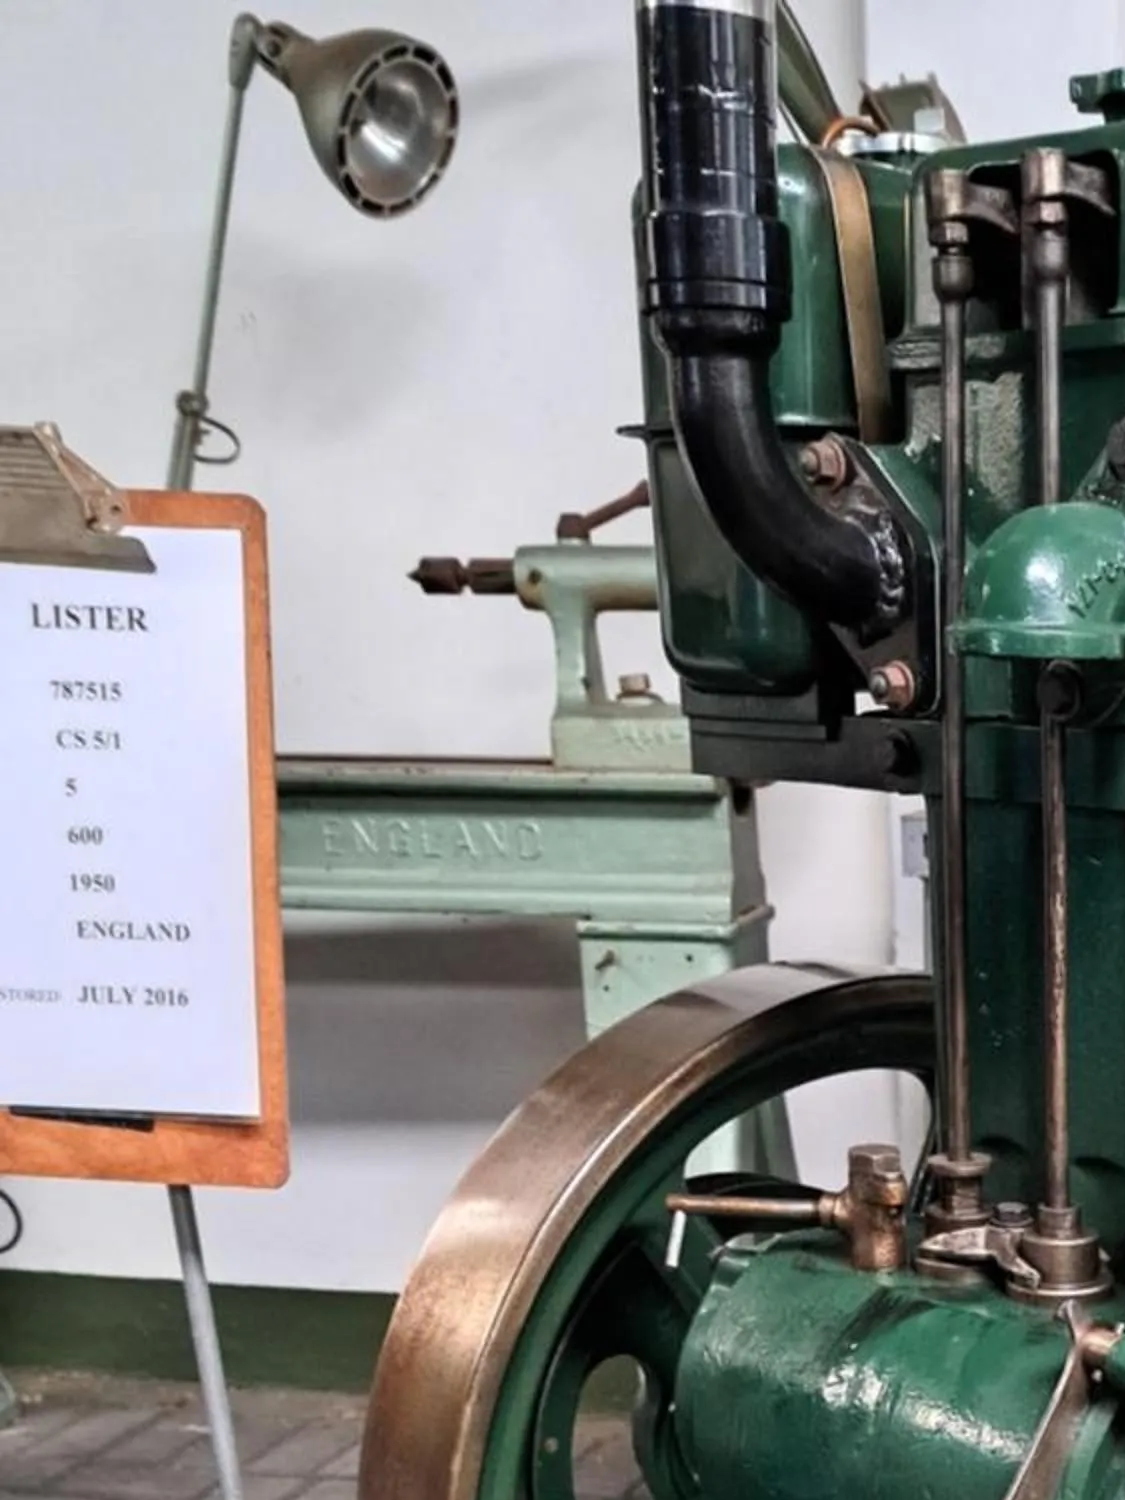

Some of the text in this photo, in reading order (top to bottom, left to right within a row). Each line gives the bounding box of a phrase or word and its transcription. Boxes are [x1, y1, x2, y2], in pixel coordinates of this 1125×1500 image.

[31, 602, 149, 632] LISTER
[50, 680, 122, 701] 787515
[56, 730, 121, 750] CS 5/1
[65, 777, 78, 797] 5
[67, 826, 104, 845] 600
[322, 818, 543, 862] ENGLAND
[70, 873, 116, 893] 1950
[77, 921, 191, 942] ENGLAND
[77, 985, 135, 1004] JULY
[144, 988, 190, 1007] 2016
